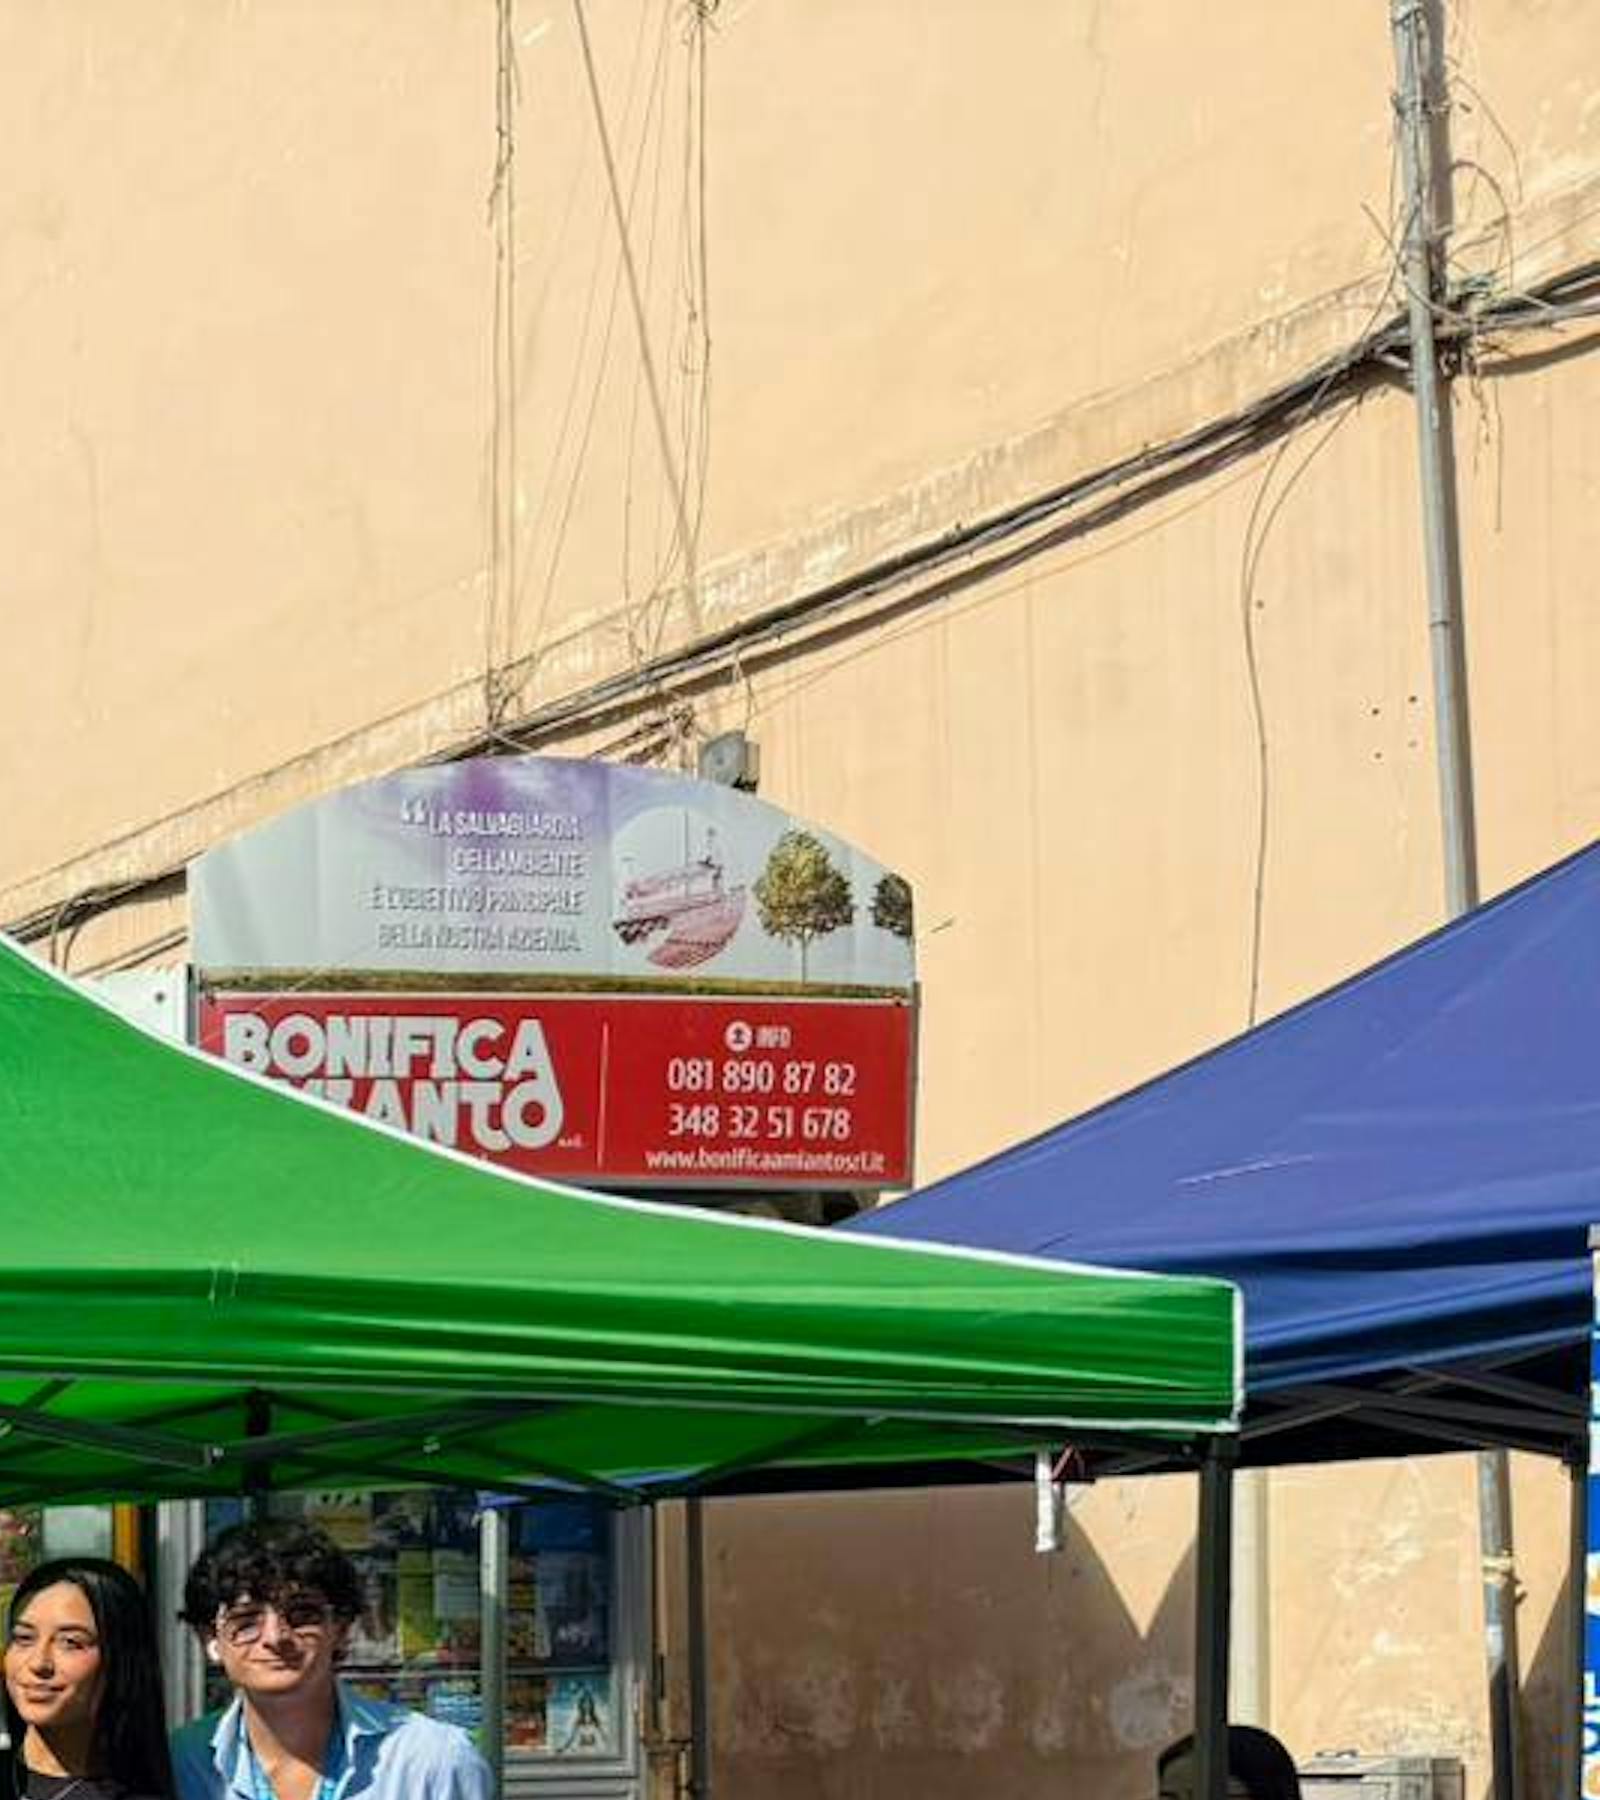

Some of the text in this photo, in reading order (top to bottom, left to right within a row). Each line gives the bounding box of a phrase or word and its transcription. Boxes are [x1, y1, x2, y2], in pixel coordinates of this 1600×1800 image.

[224, 1012, 554, 1081] BONIFICA
[667, 1057, 857, 1097] 081 890 87 82
[667, 1103, 852, 1141] 348 32 51 678
[645, 1146, 886, 1175] www.bonificaamiantosrl.it
